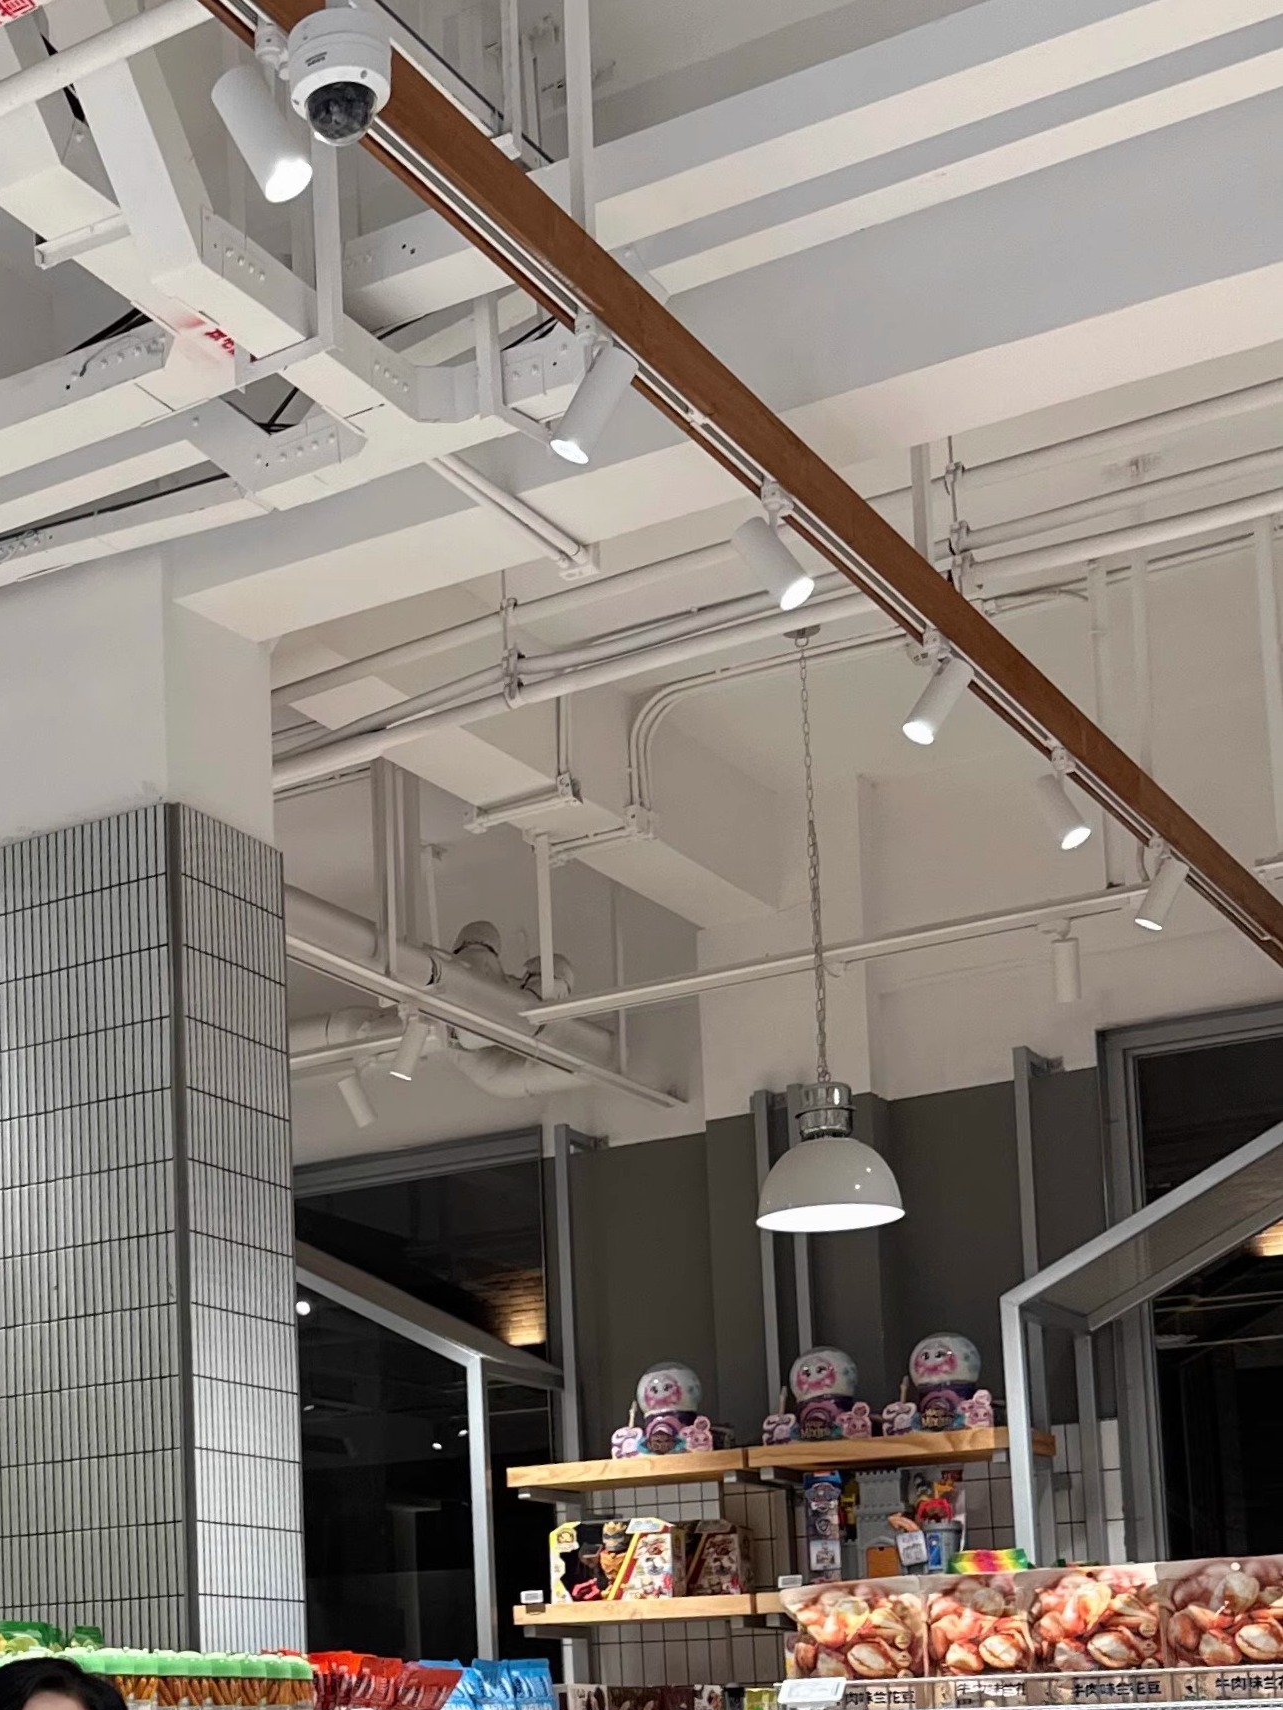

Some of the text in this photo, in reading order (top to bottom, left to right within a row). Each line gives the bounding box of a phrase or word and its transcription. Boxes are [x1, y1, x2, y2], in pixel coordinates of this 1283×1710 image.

[845, 1690, 916, 1705] 肉味兰花豆
